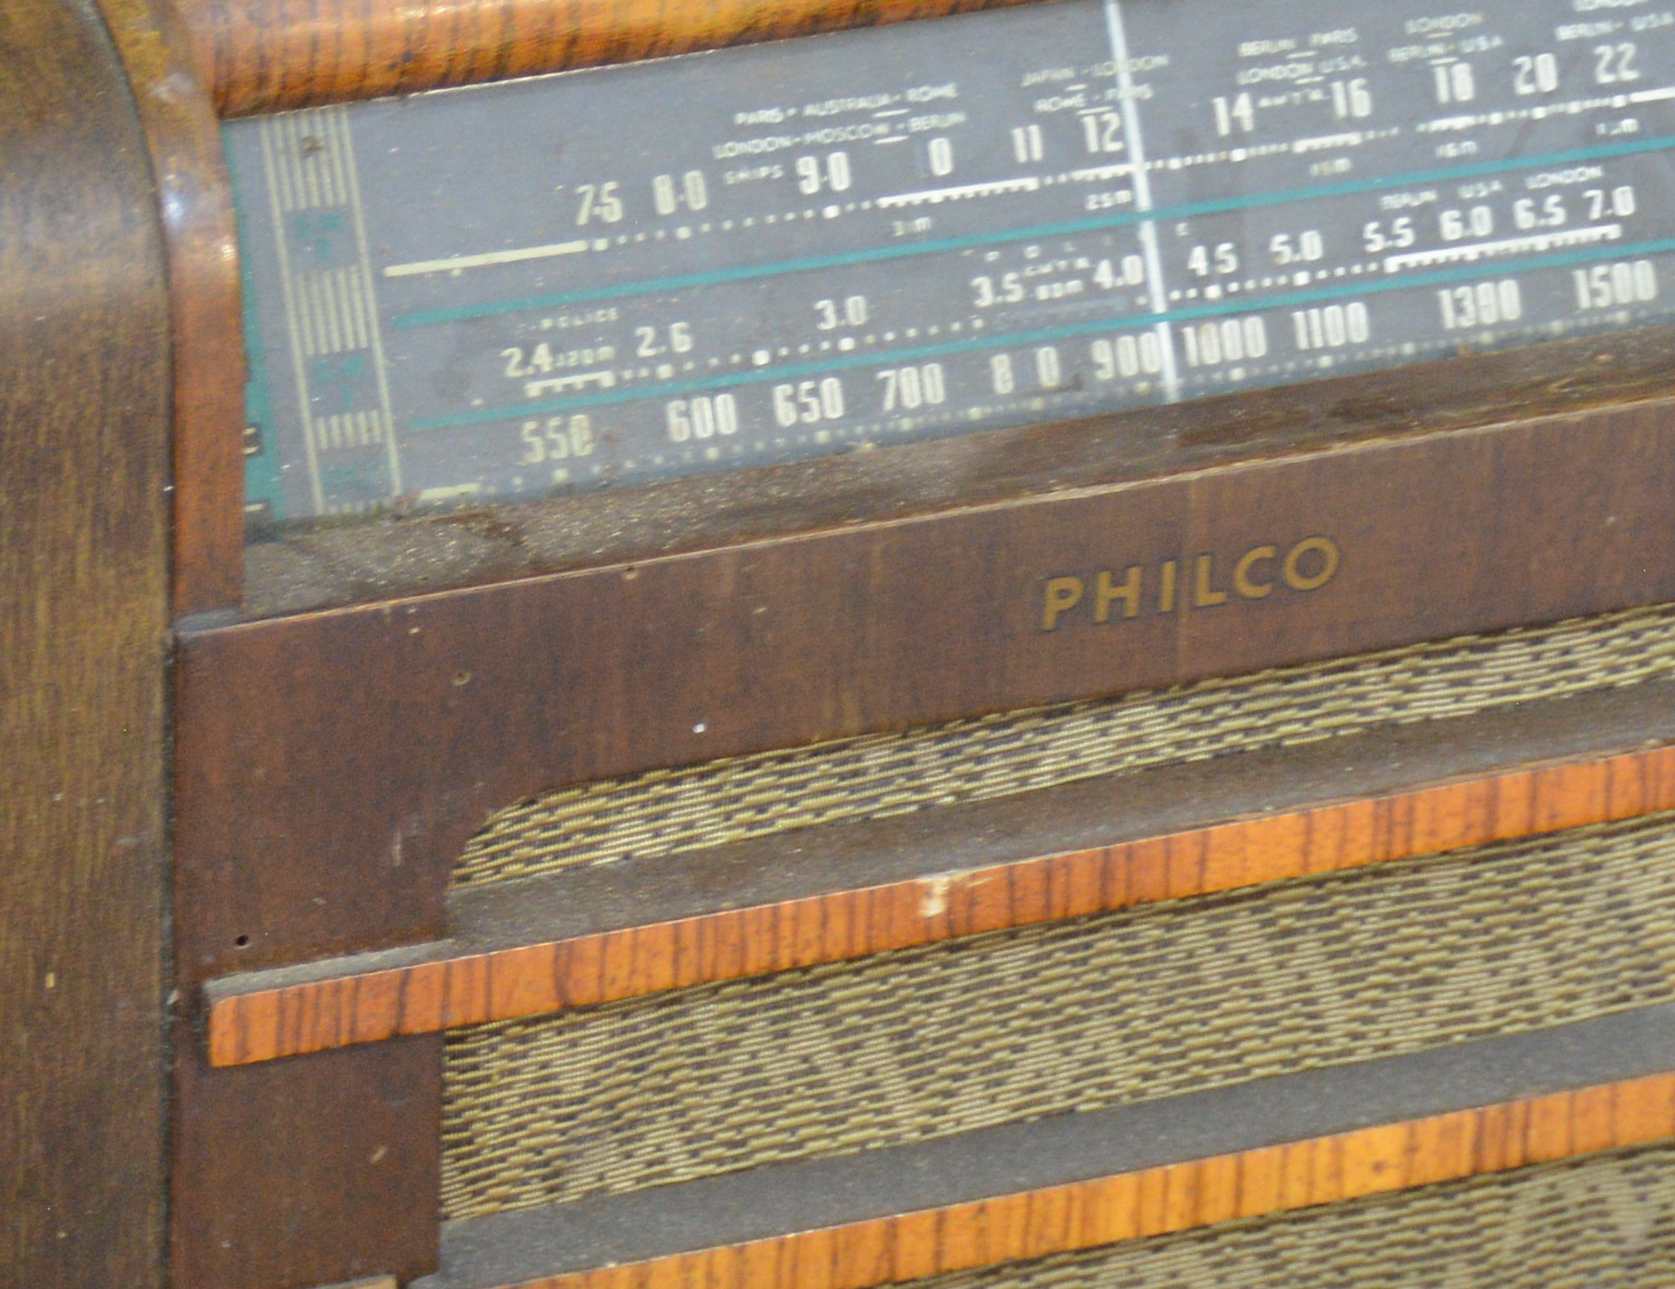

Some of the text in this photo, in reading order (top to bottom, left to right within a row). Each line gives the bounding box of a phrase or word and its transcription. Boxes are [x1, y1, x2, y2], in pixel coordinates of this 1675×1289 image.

[1011, 123, 1044, 164] 11
[1081, 113, 1125, 154] 12
[1214, 92, 1254, 137] 14
[1330, 78, 1372, 118] 16
[1512, 53, 1559, 96] 20
[1593, 42, 1642, 85] 22
[1525, 165, 1604, 190] LONDON
[499, 343, 553, 377] 2.4
[635, 321, 693, 357] 2.6
[814, 294, 869, 331] 3.0
[971, 271, 1023, 309] 3.5
[1092, 254, 1144, 291] 4.0
[1269, 229, 1324, 265] 5.0
[1362, 217, 1417, 253] 5.5
[1438, 204, 1494, 242] 6.0
[1513, 194, 1567, 230] 6.5
[1582, 185, 1637, 220] 7.0
[523, 414, 593, 464] 550
[666, 394, 737, 443] 600
[772, 376, 846, 428] 650
[876, 362, 946, 412] 700
[1090, 332, 1162, 381] 900
[1181, 315, 1269, 368] 1000
[1290, 301, 1370, 352] 1100
[1570, 259, 1659, 310] 1500
[1041, 536, 1340, 632] PHILCO
